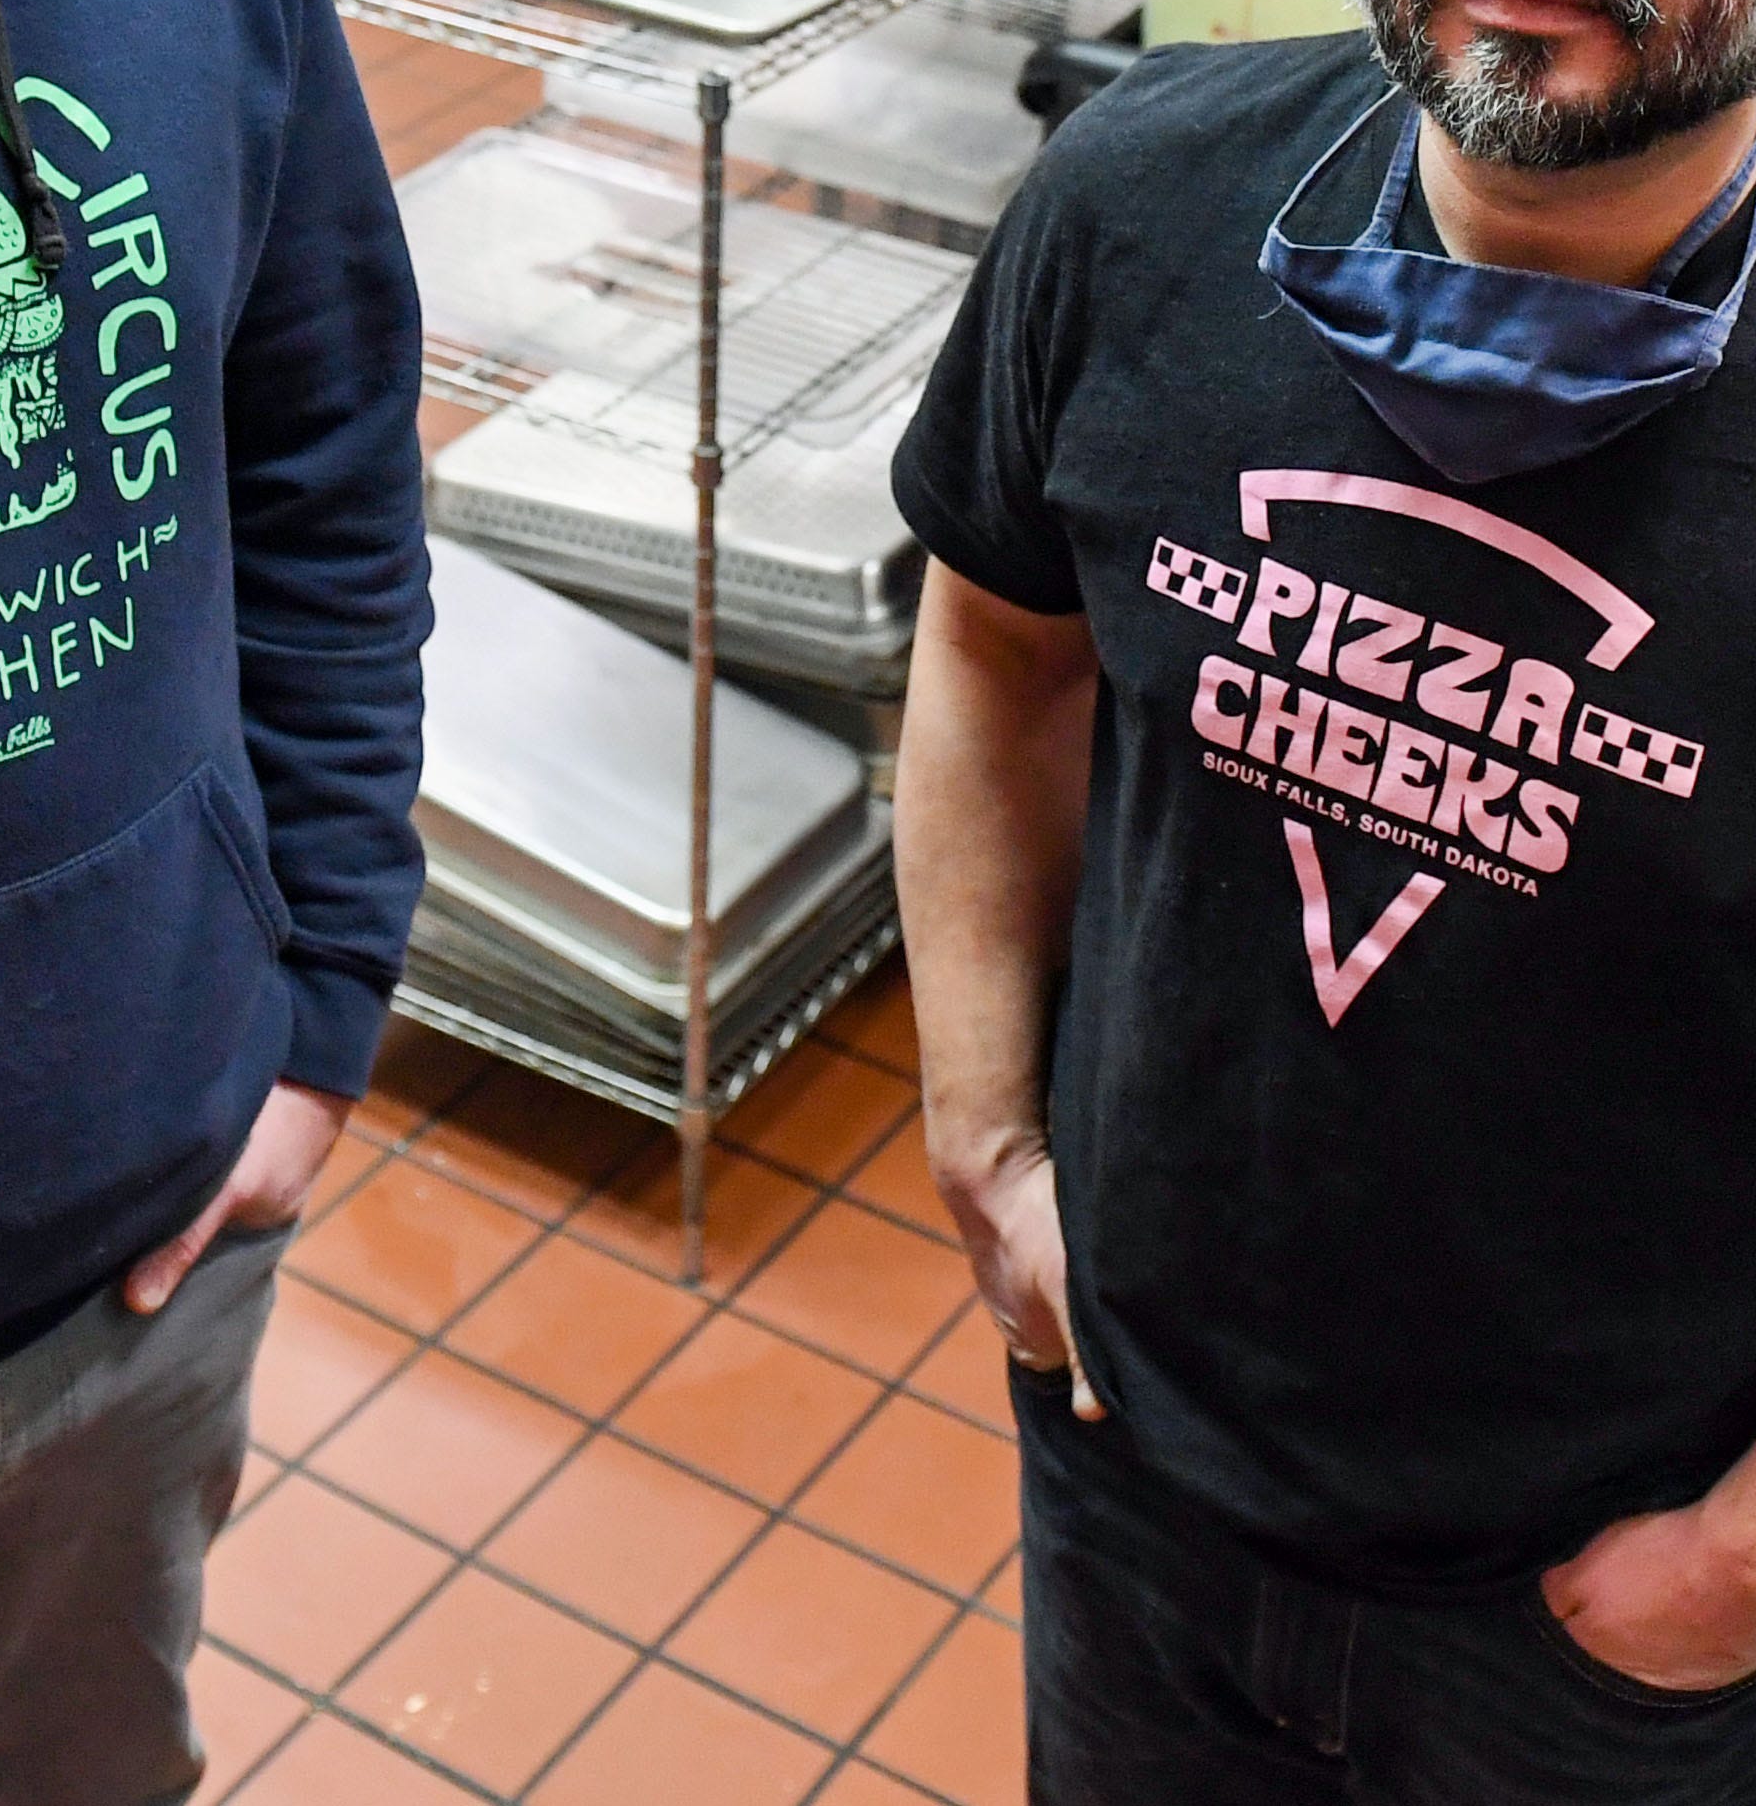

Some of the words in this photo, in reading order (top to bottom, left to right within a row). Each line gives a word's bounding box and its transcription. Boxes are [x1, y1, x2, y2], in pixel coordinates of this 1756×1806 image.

[6, 715, 52, 752] Falls
[1236, 556, 1576, 765] PIZZA
[1190, 655, 1581, 873] CHEEKS
[1202, 750, 1269, 792] SIOUX
[1275, 778, 1351, 827] FALLS,
[1358, 813, 1439, 858] SOUTH
[1444, 846, 1539, 897] DAKOTA
